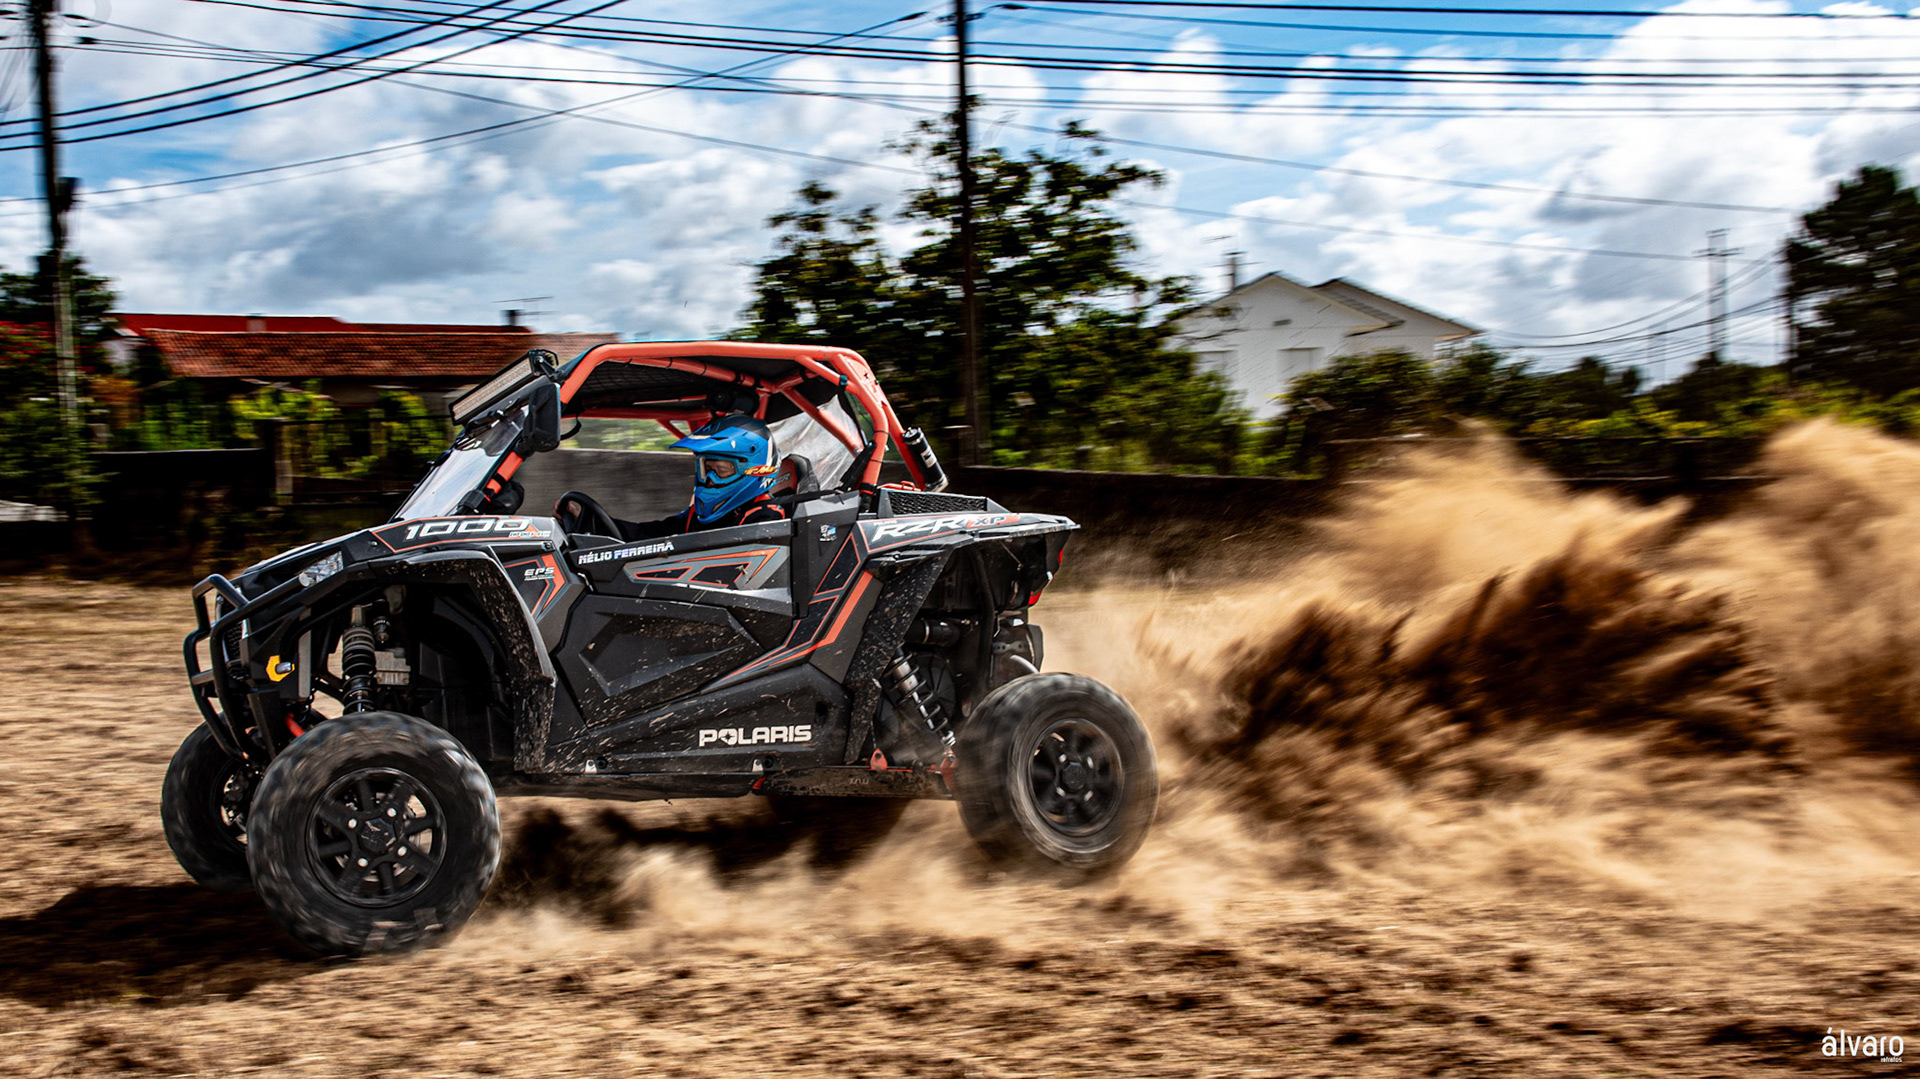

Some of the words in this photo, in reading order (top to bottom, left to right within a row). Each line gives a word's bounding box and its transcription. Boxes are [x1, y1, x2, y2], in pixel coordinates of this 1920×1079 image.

[406, 518, 531, 540] 1000
[871, 518, 966, 542] RZR
[971, 515, 1006, 526] XP
[614, 541, 675, 559] FERREIRA
[524, 567, 555, 576] EPS
[699, 724, 812, 747] POLARIS
